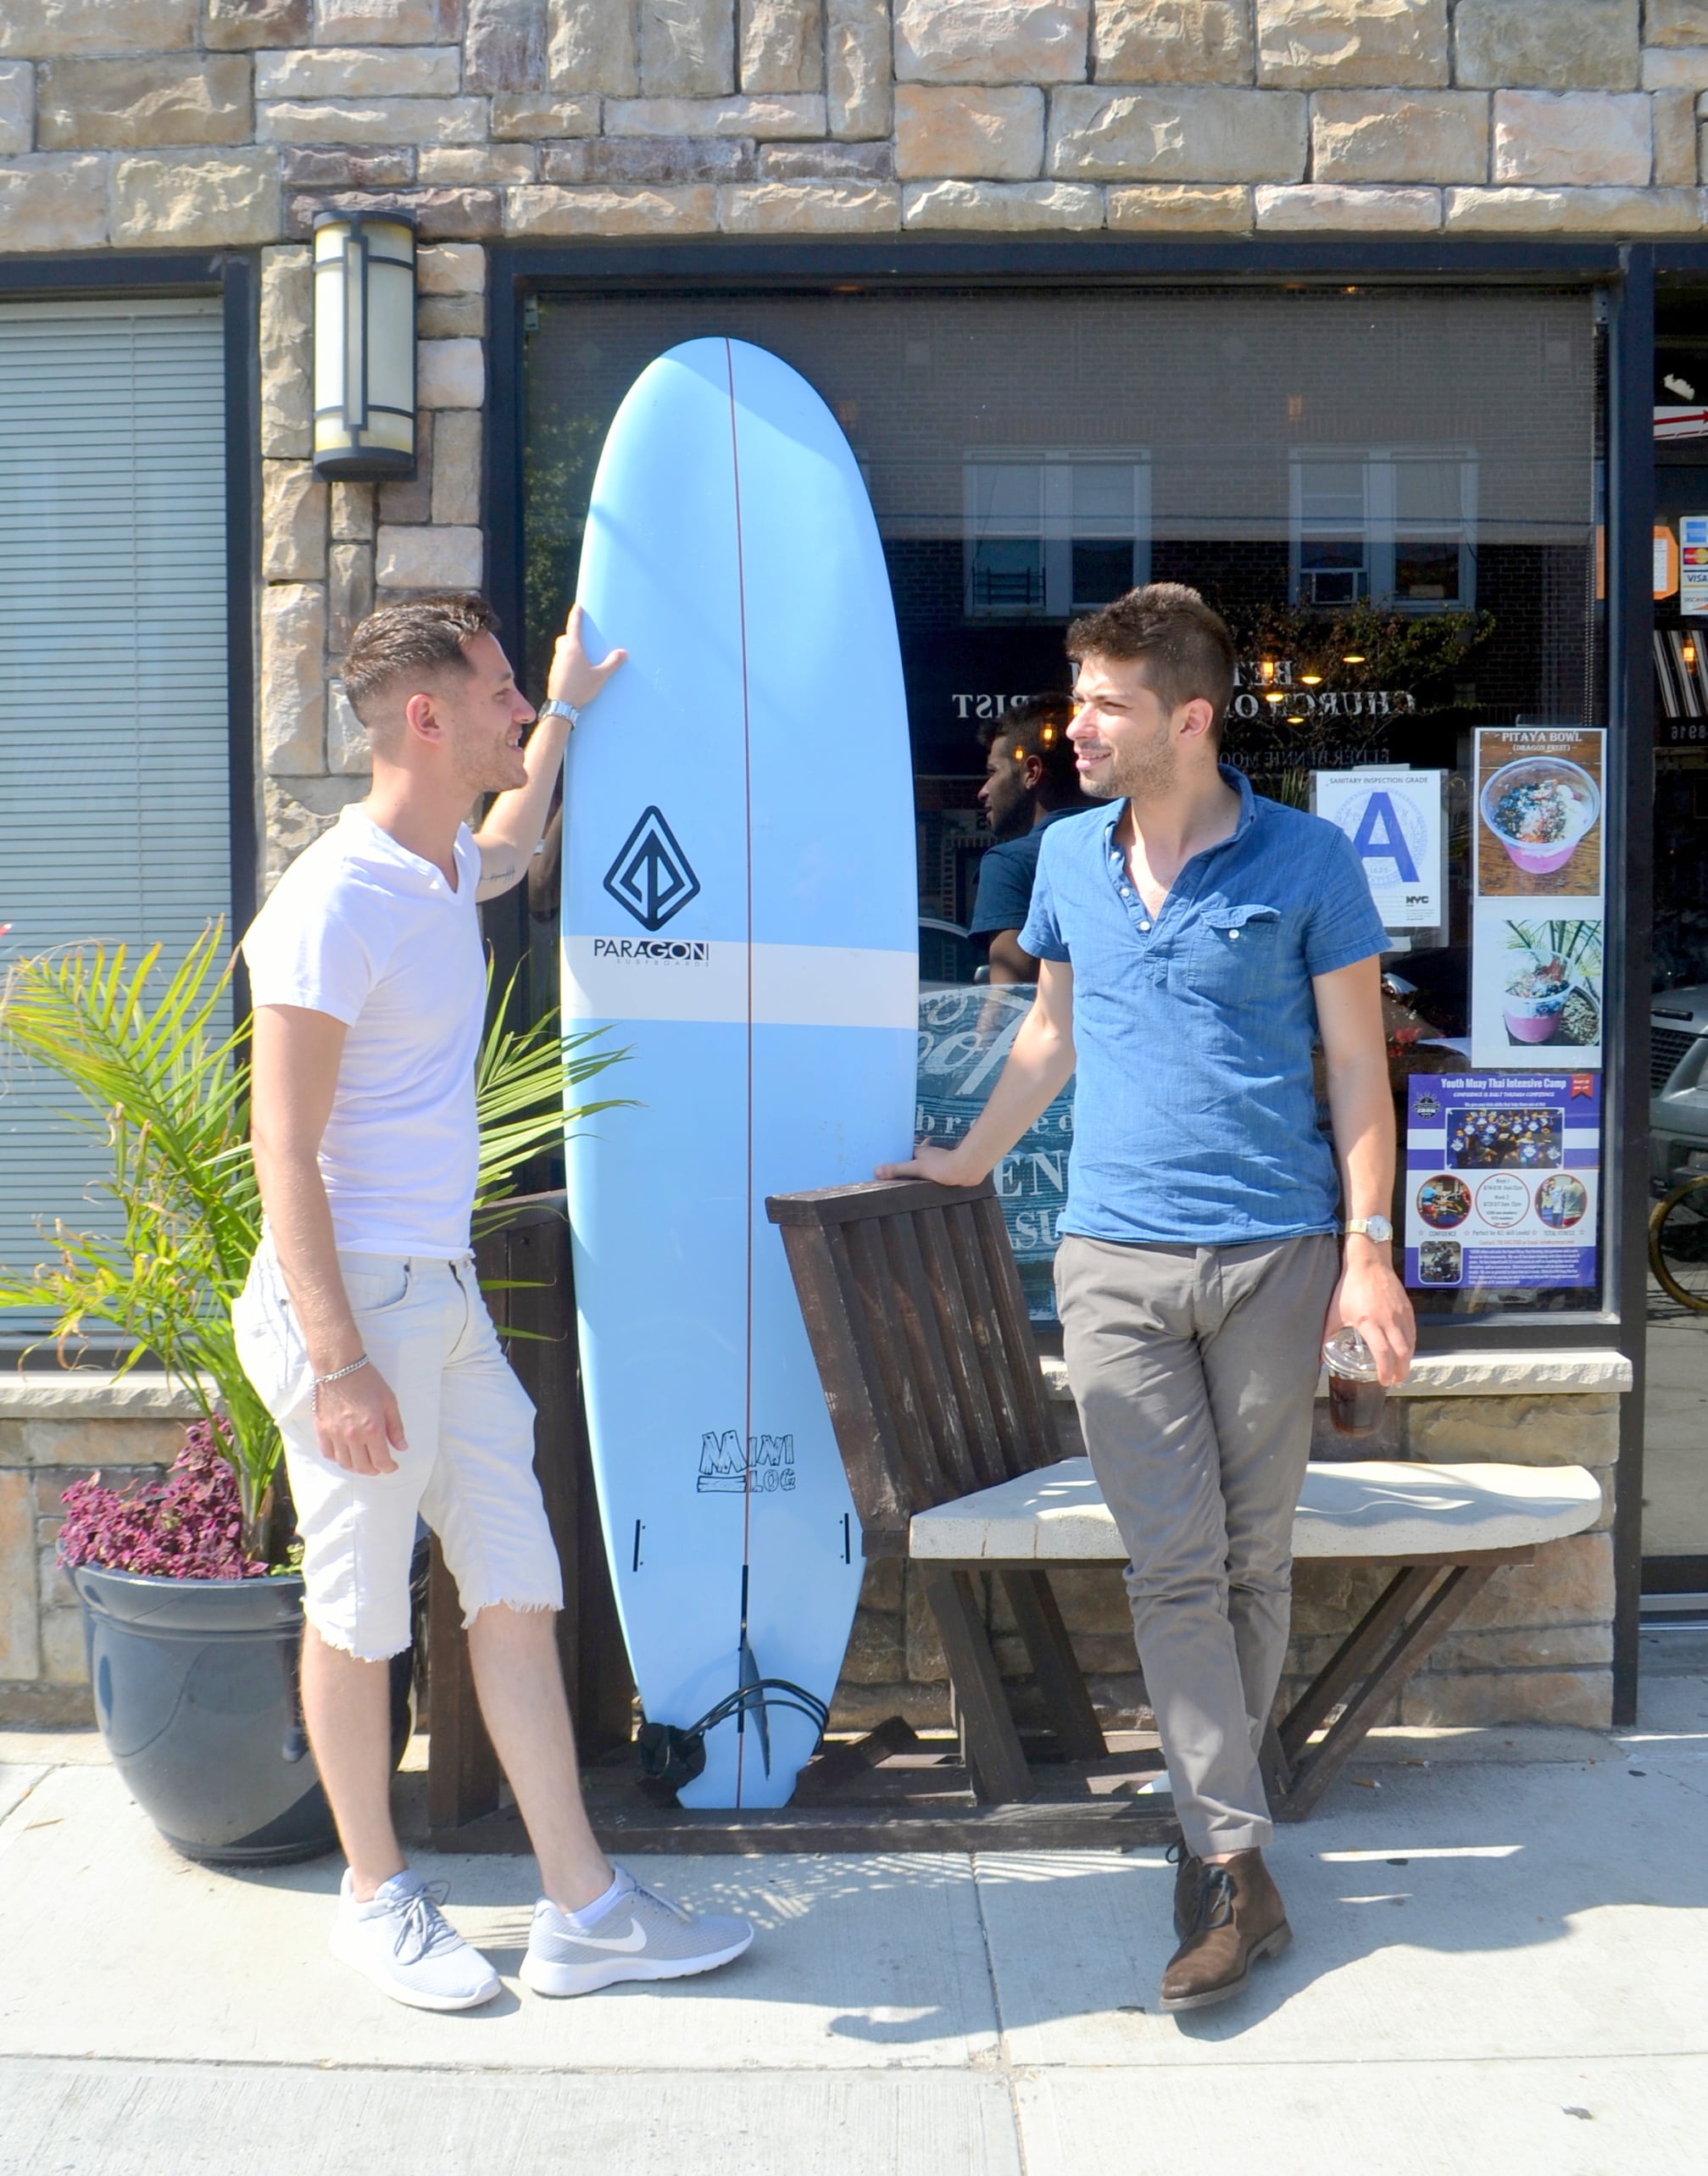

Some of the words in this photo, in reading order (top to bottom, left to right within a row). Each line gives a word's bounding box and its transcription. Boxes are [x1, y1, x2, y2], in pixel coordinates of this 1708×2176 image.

[1502, 732, 1546, 742] PITAYA
[1549, 731, 1583, 742] BOWL
[1353, 792, 1421, 882] A
[593, 938, 709, 961] PARAGON
[616, 959, 709, 967] SURFBOARDS
[1441, 1077, 1465, 1088] Youth
[1465, 1077, 1488, 1089] Muay
[1488, 1077, 1505, 1088] Thai
[1506, 1077, 1543, 1088] Intensive
[1544, 1077, 1566, 1089] Camp
[698, 1429, 794, 1476] MINI
[749, 1468, 796, 1493] LOG
